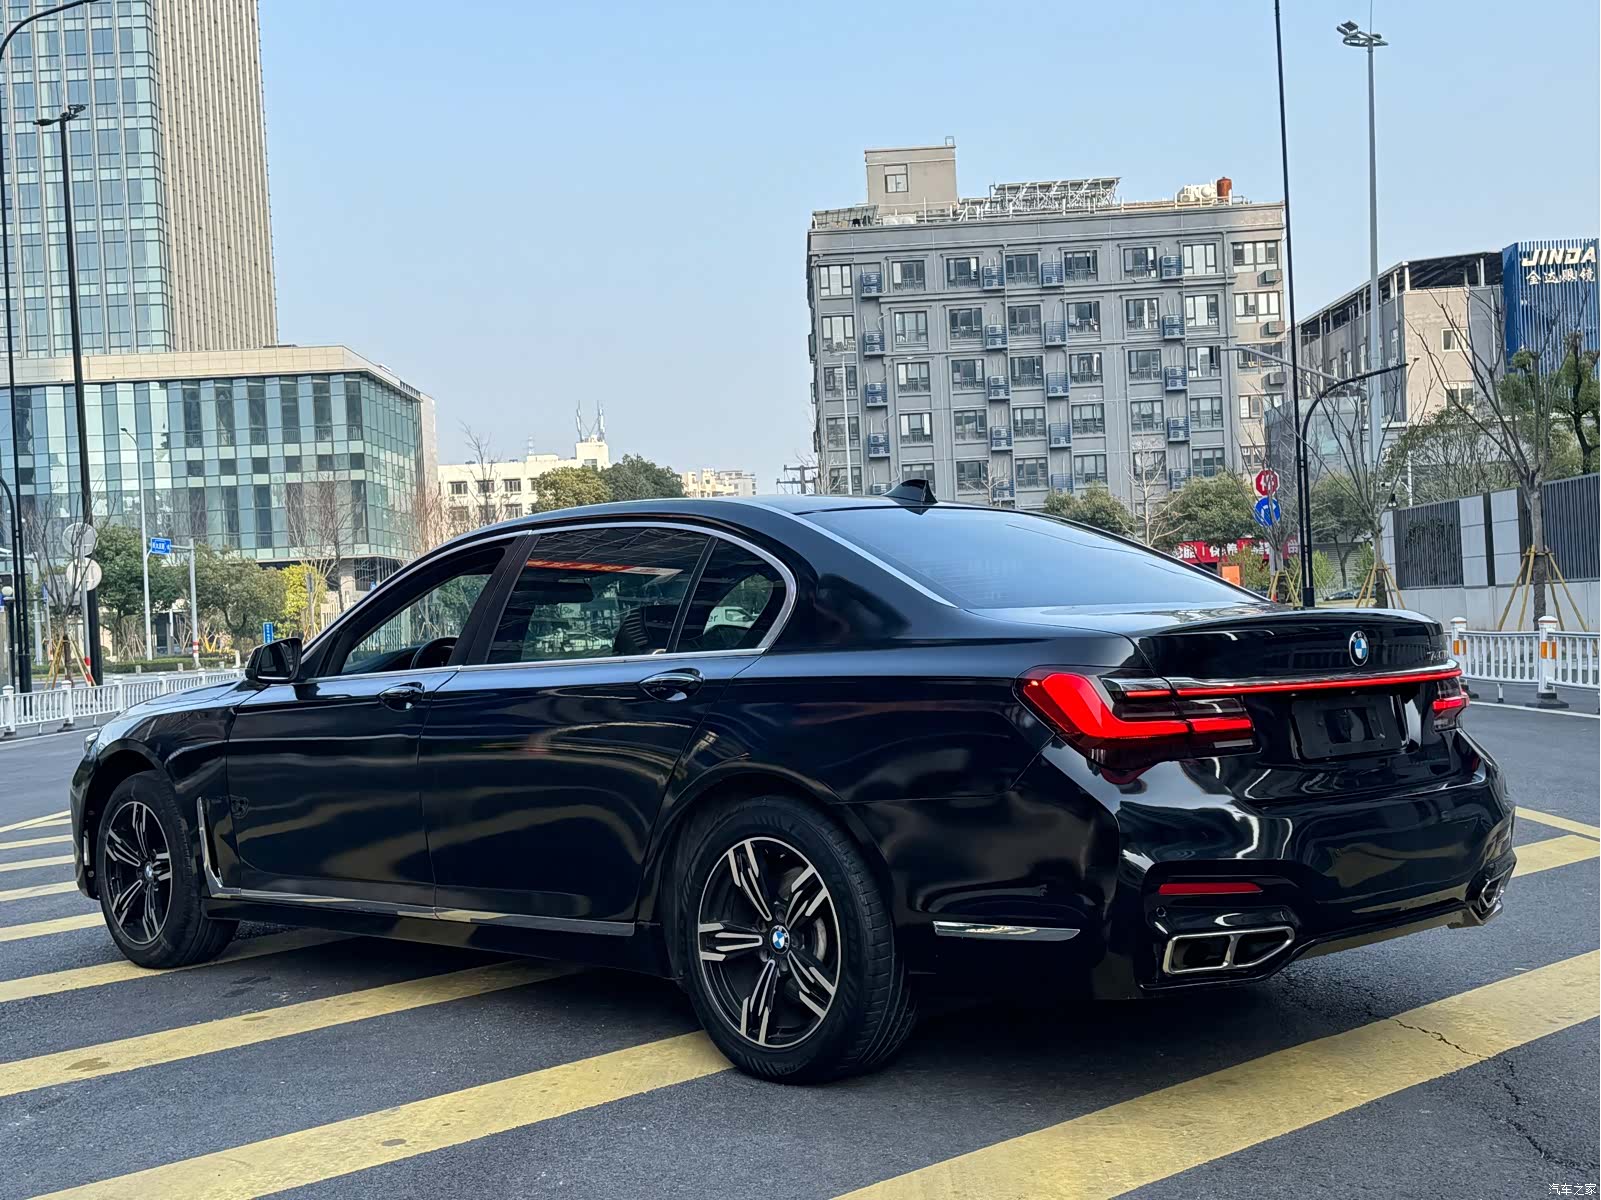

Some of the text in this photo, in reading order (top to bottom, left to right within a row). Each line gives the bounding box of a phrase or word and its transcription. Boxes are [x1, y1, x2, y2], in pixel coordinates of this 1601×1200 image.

[1521, 246, 1597, 267] JINDA
[1525, 267, 1596, 285] 金达眼镜
